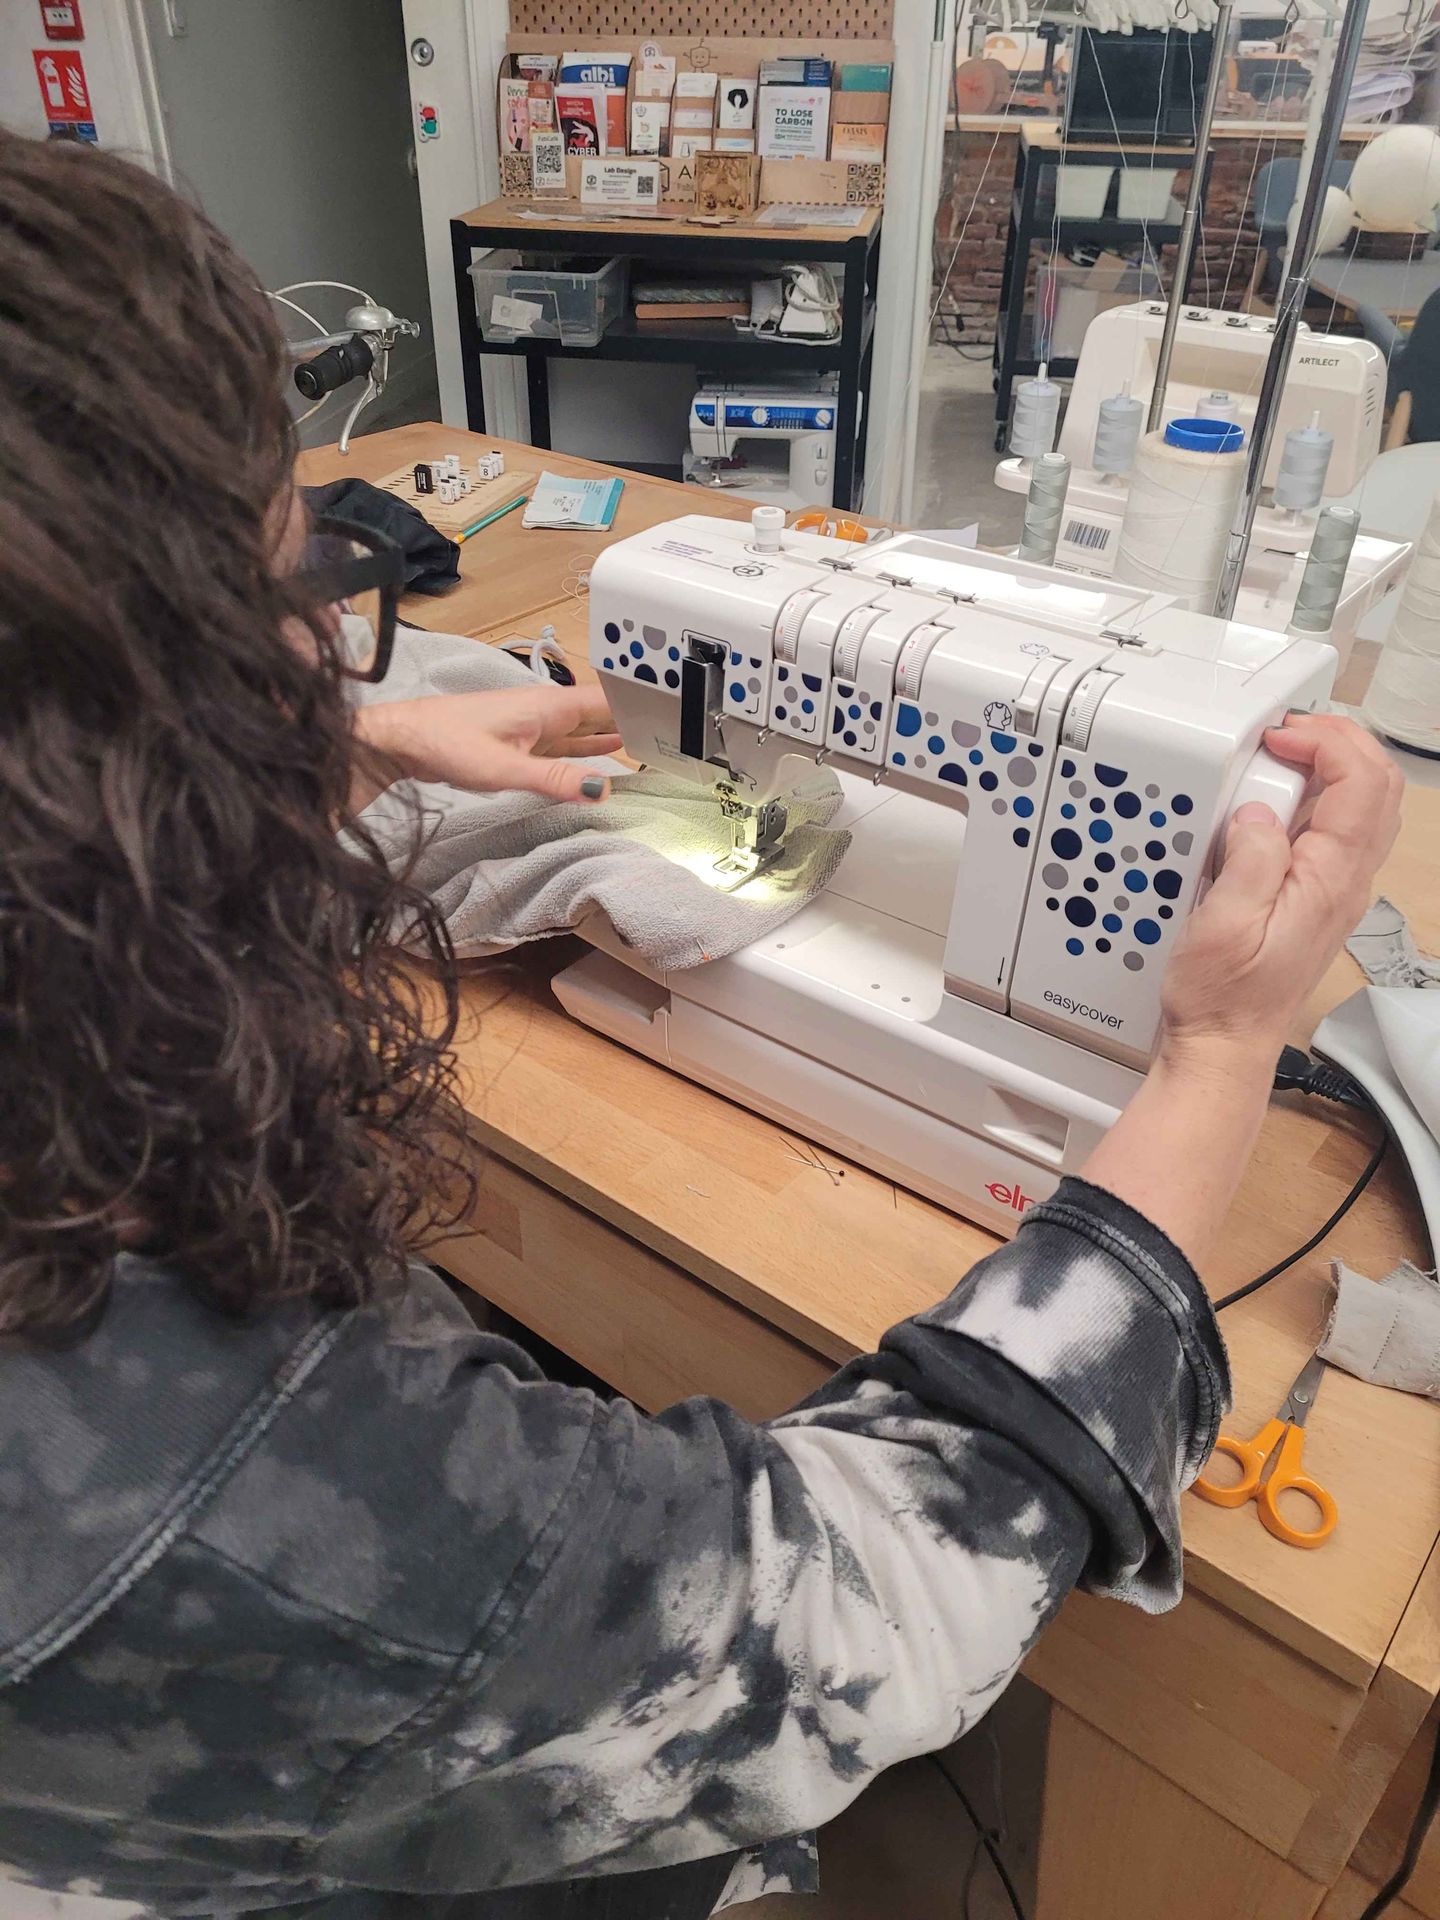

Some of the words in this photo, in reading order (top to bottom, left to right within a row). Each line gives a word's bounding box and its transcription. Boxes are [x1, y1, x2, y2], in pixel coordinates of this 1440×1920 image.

[580, 66, 615, 83] albi
[775, 108, 787, 117] TO
[790, 109, 813, 118] LOSE
[775, 117, 813, 126] CARBON
[567, 147, 597, 156] CYBER
[1298, 356, 1340, 367] ARTILECT
[1043, 990, 1124, 1030] easycover
